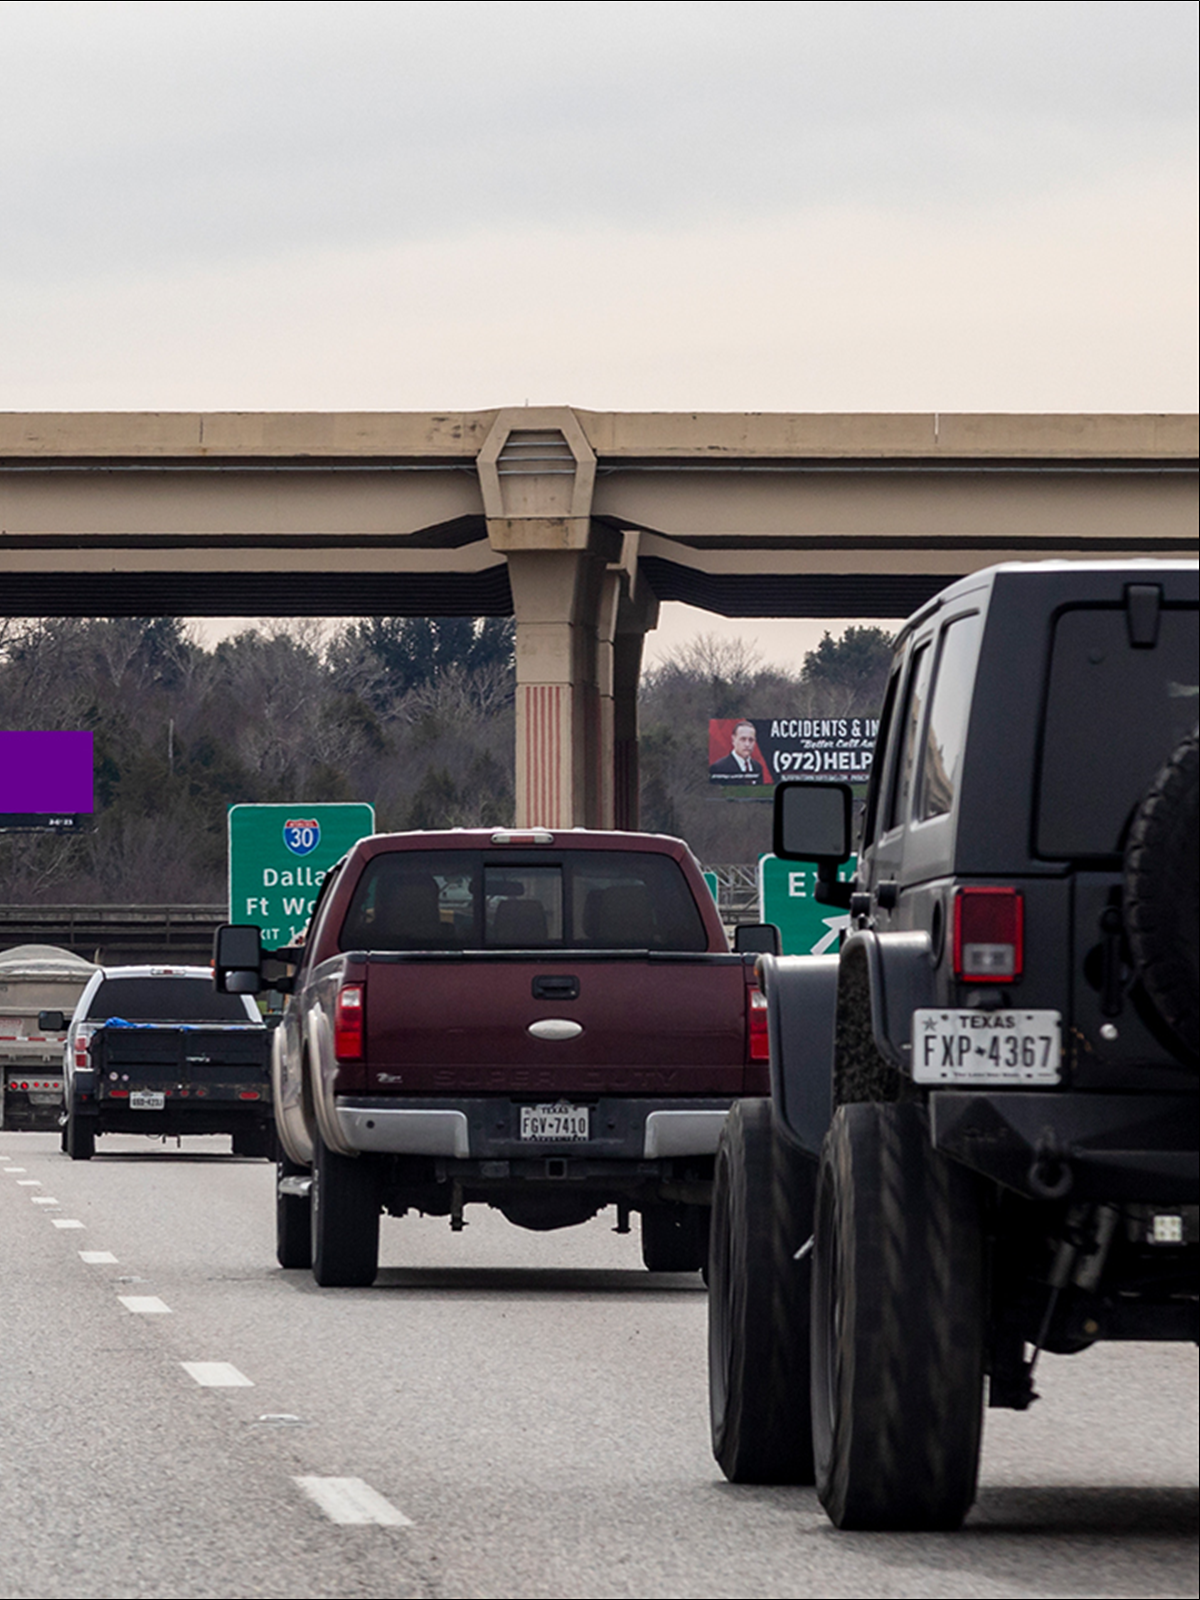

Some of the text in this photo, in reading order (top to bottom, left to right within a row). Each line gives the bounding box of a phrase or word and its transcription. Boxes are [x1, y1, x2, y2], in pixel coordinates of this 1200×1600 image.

[771, 719, 879, 738] ACCIDENTS & IN
[290, 828, 314, 848] 30
[263, 867, 327, 887] Dalla
[246, 897, 317, 916] Ft Wo
[959, 1015, 1016, 1029] TEXAS
[541, 1106, 569, 1114] TEXAS
